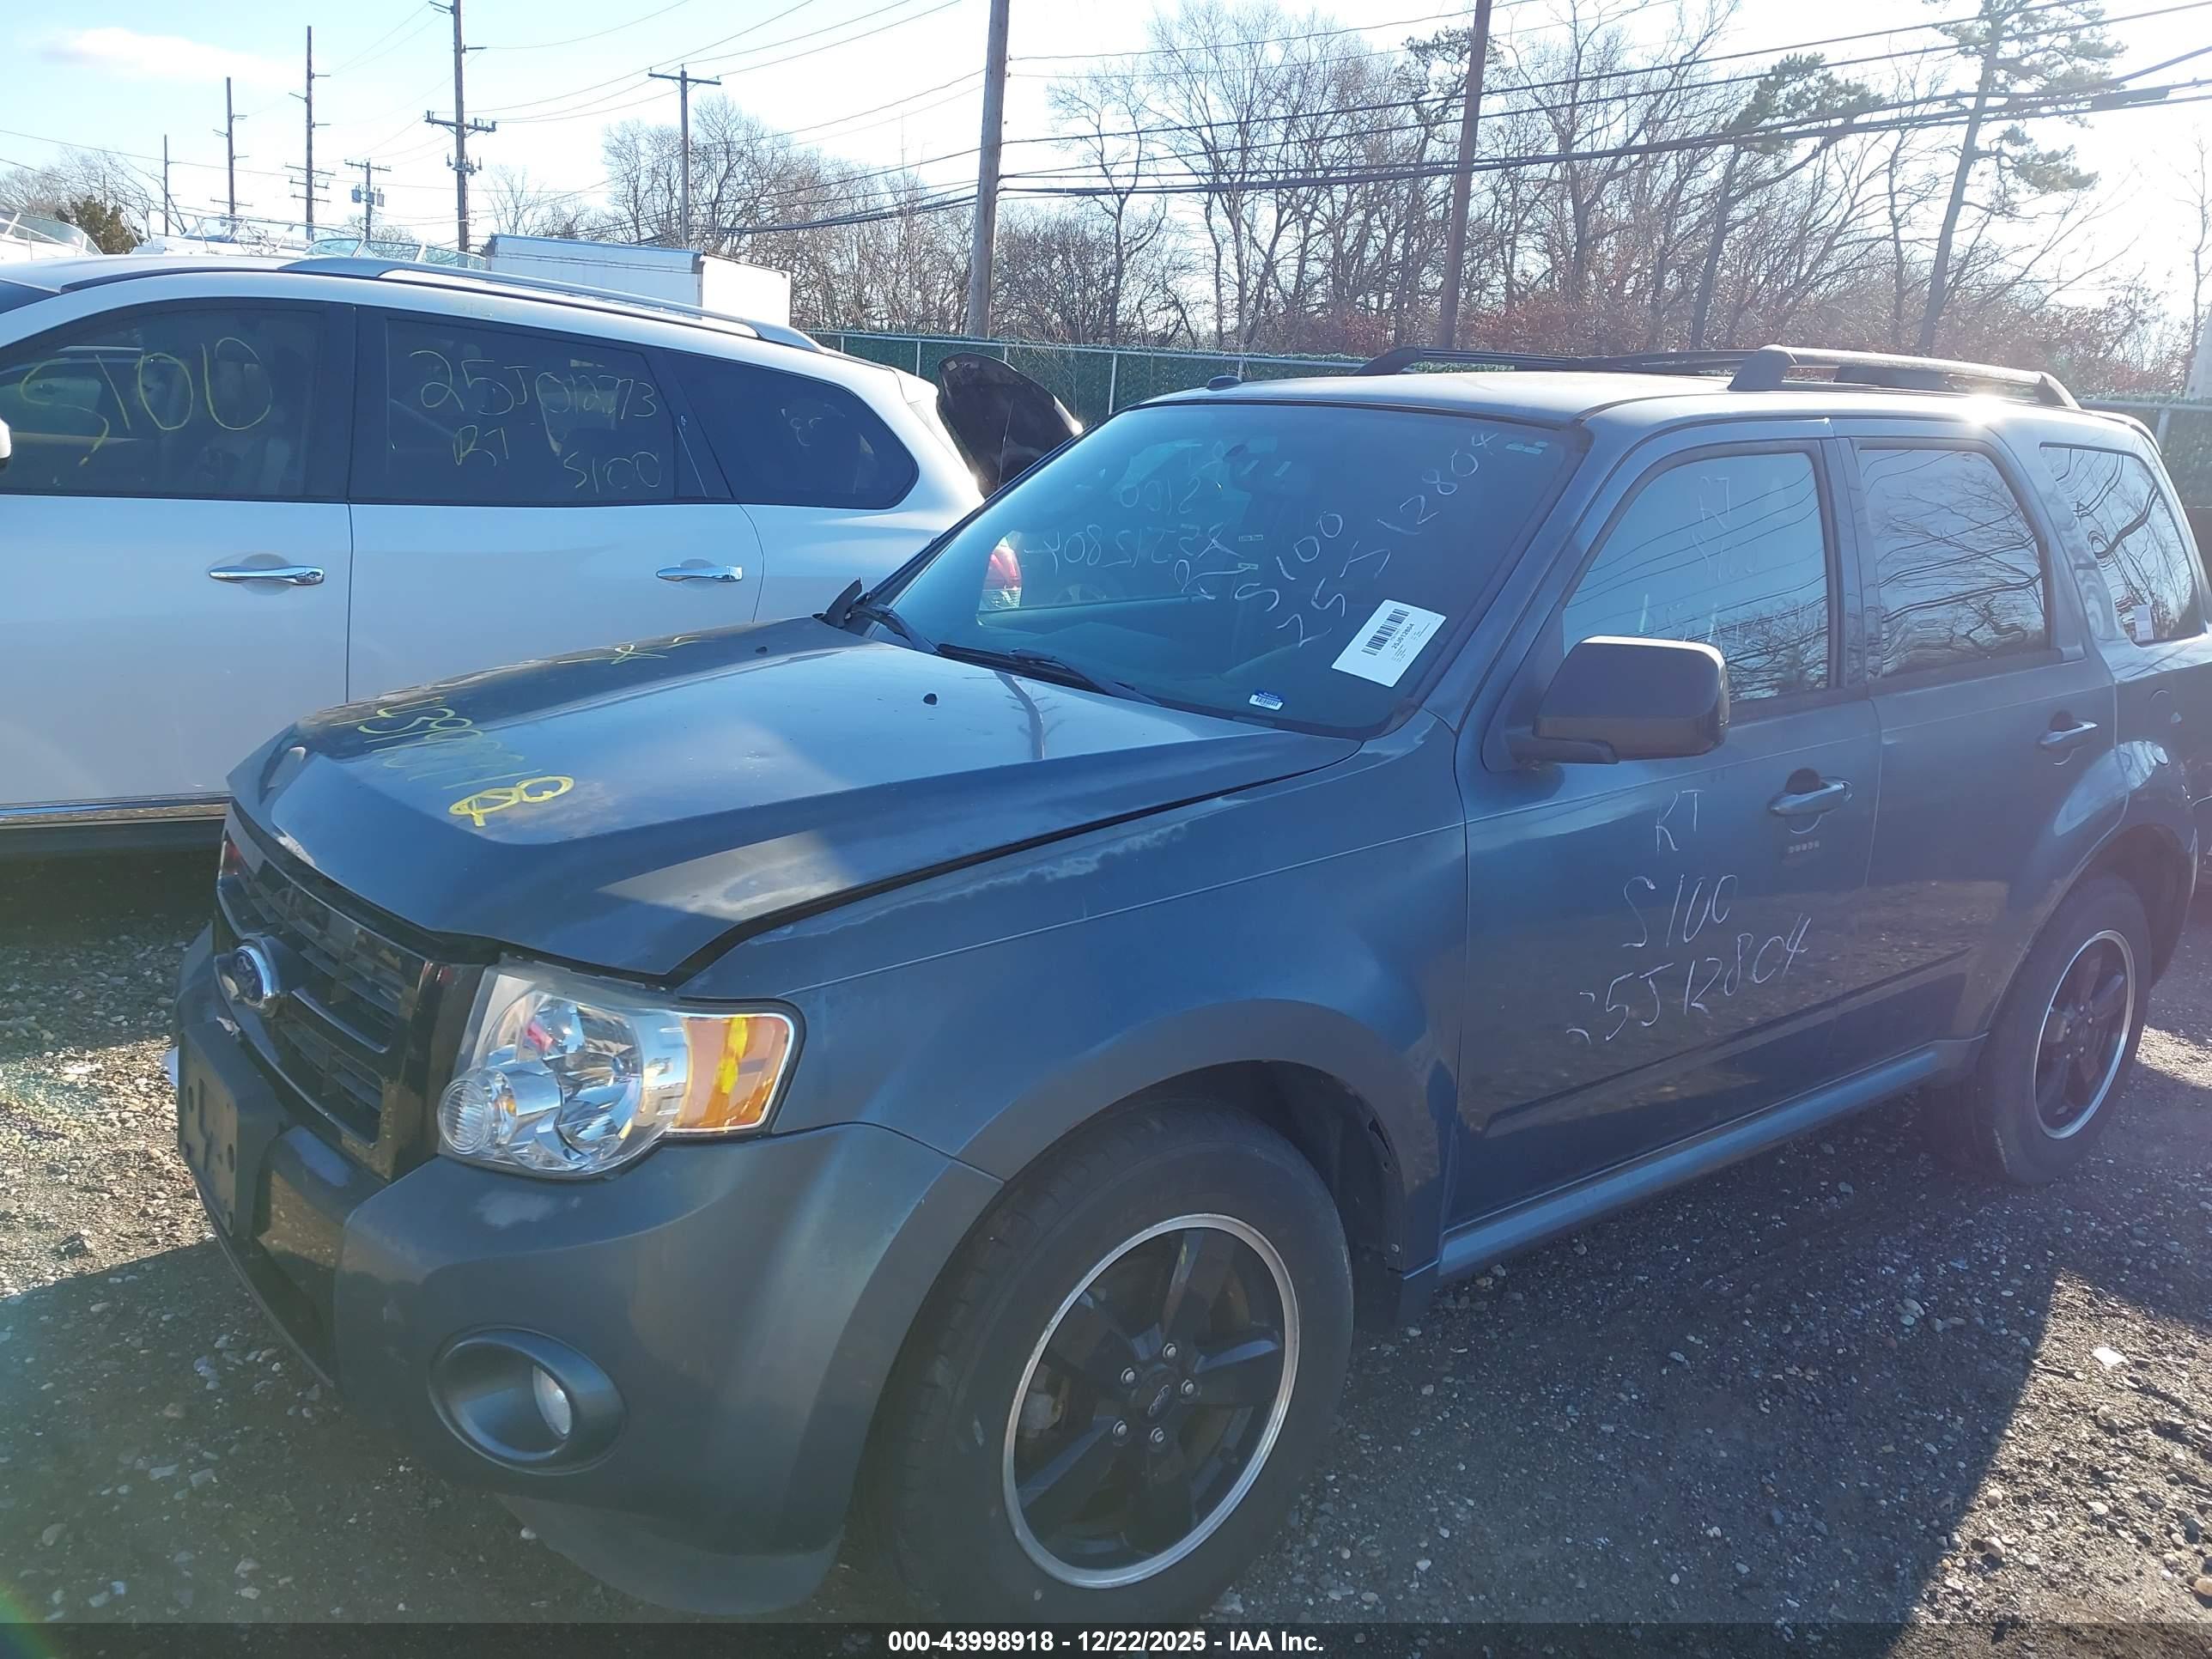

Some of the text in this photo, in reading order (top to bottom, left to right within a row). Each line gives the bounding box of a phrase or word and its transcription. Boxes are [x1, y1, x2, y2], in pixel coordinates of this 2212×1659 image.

[20, 337, 272, 466] S100
[1233, 510, 1346, 613] S100
[1621, 873, 1738, 948] S100
